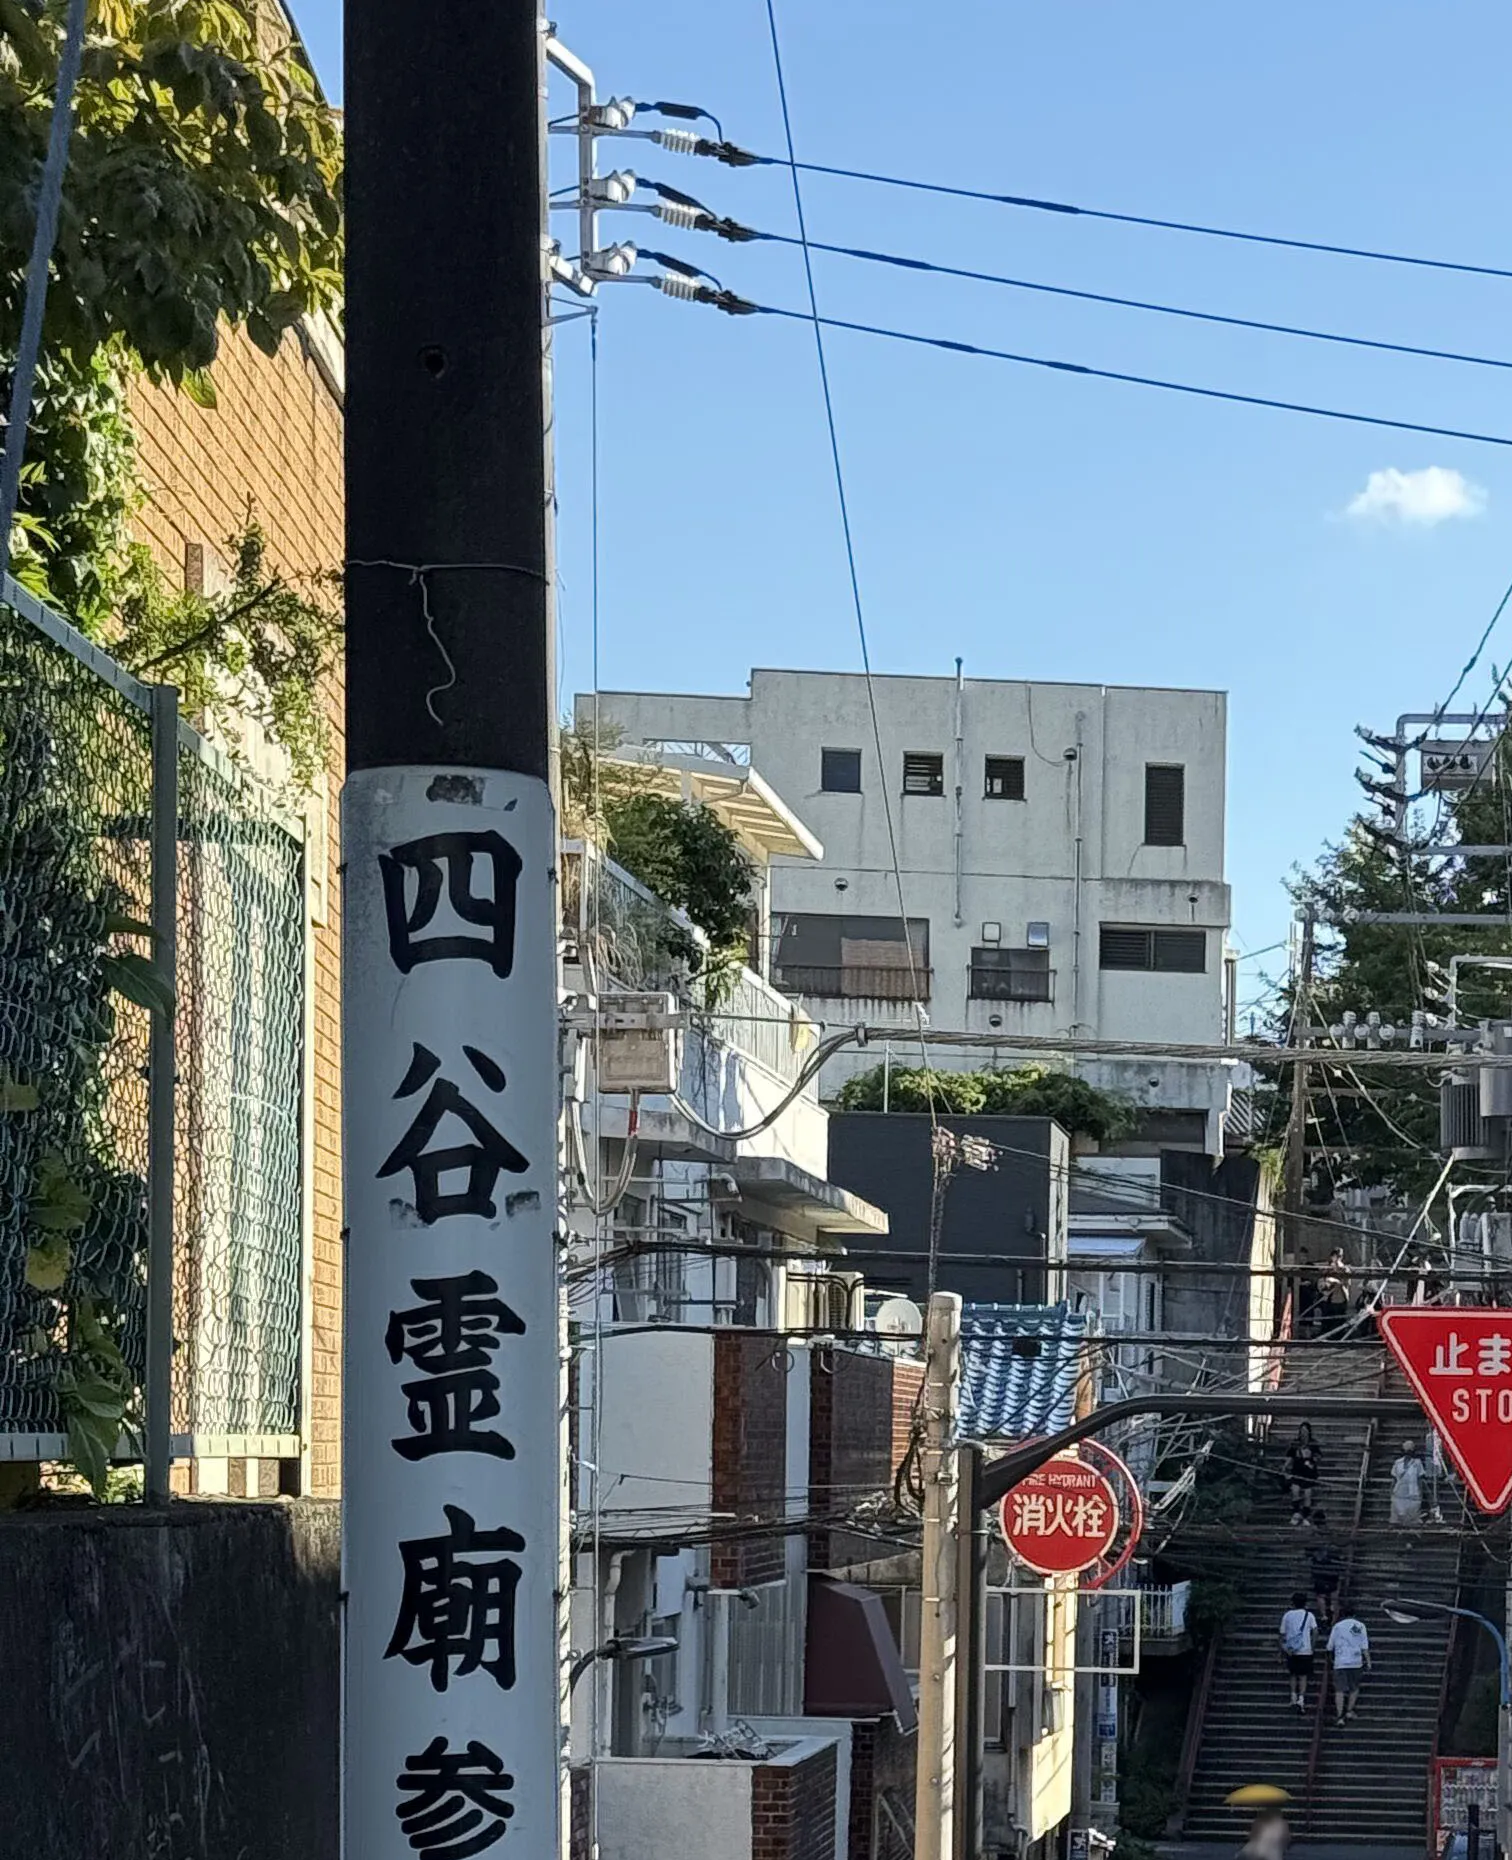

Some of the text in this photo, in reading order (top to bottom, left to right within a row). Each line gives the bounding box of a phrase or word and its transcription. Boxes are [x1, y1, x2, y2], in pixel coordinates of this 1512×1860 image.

[1048, 1473, 1097, 1490] HYDRANT
[1012, 1493, 1108, 1538] 消火栓
